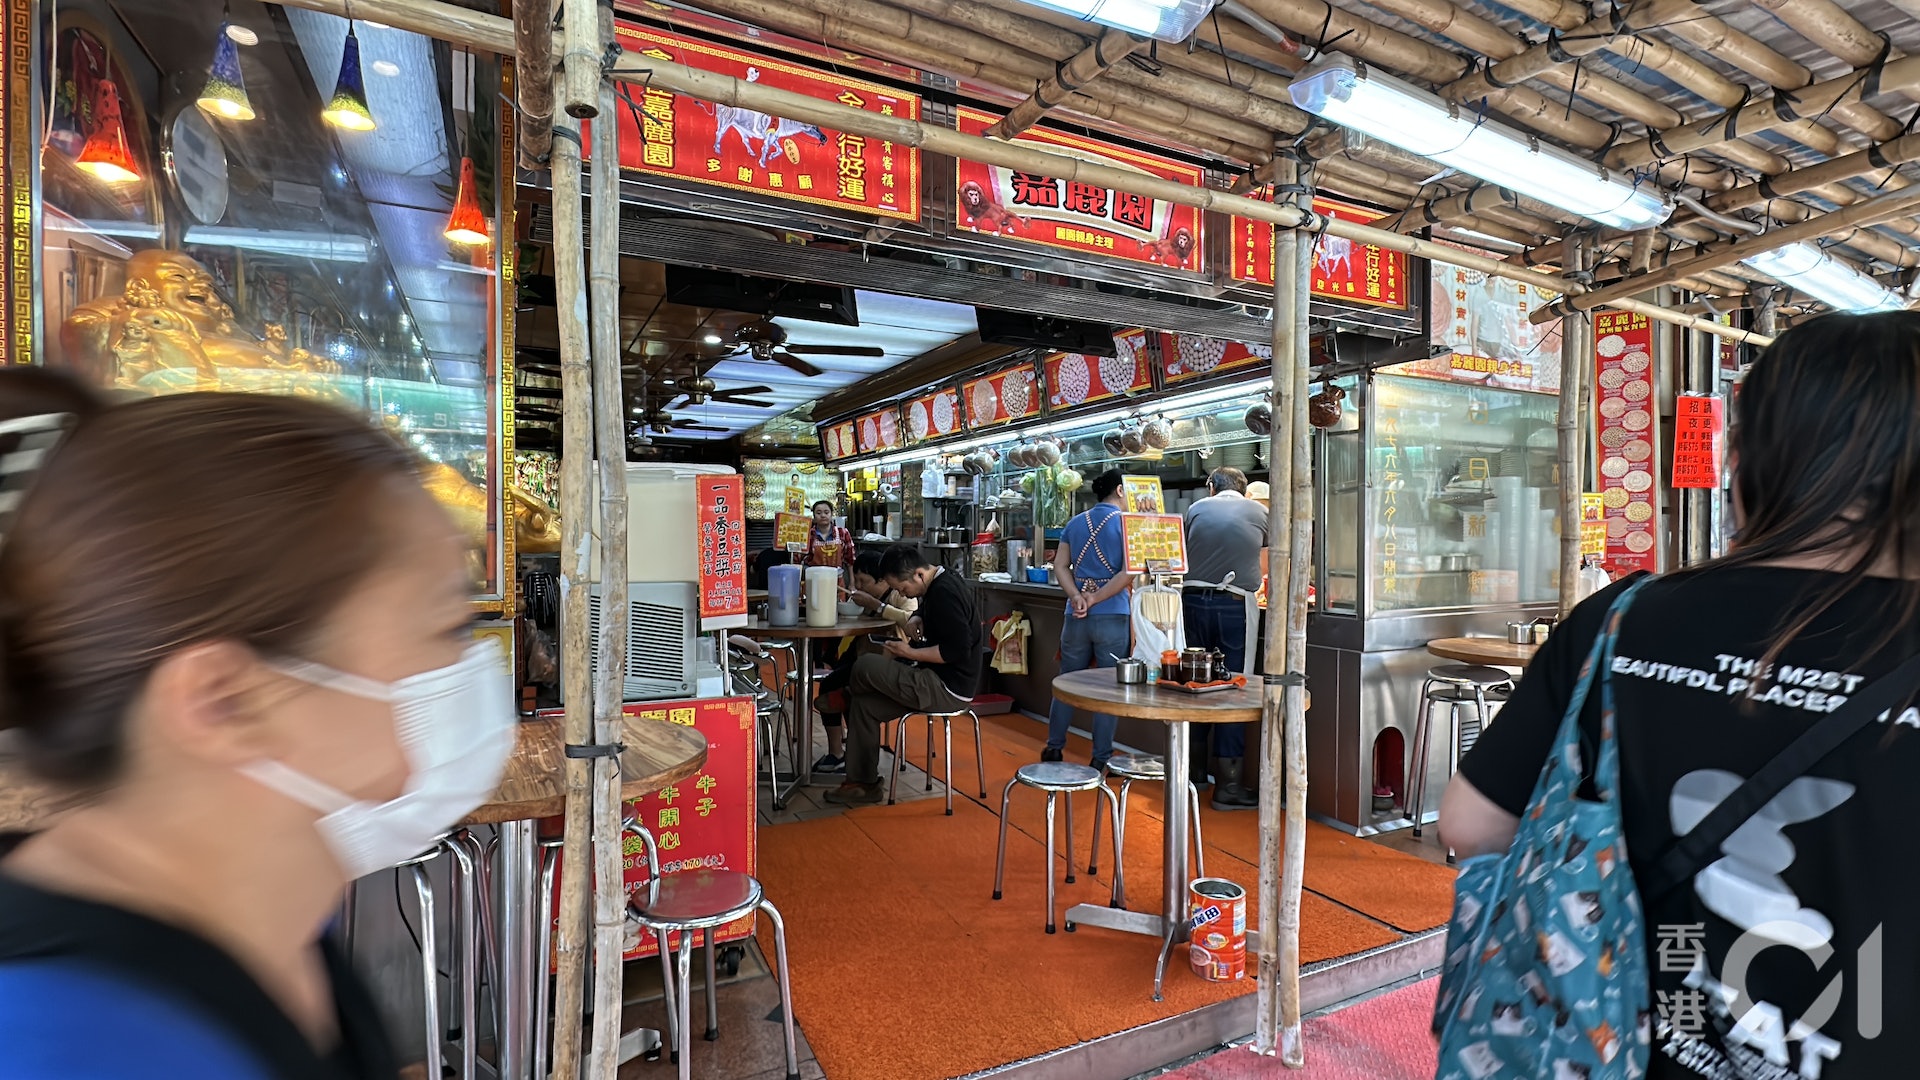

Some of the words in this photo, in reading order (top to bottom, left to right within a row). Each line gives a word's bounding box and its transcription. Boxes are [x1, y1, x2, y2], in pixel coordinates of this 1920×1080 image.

[640, 47, 675, 168] 嘉麗園
[1455, 270, 1468, 339] 真材實料
[711, 484, 731, 578] 一品香豆漿
